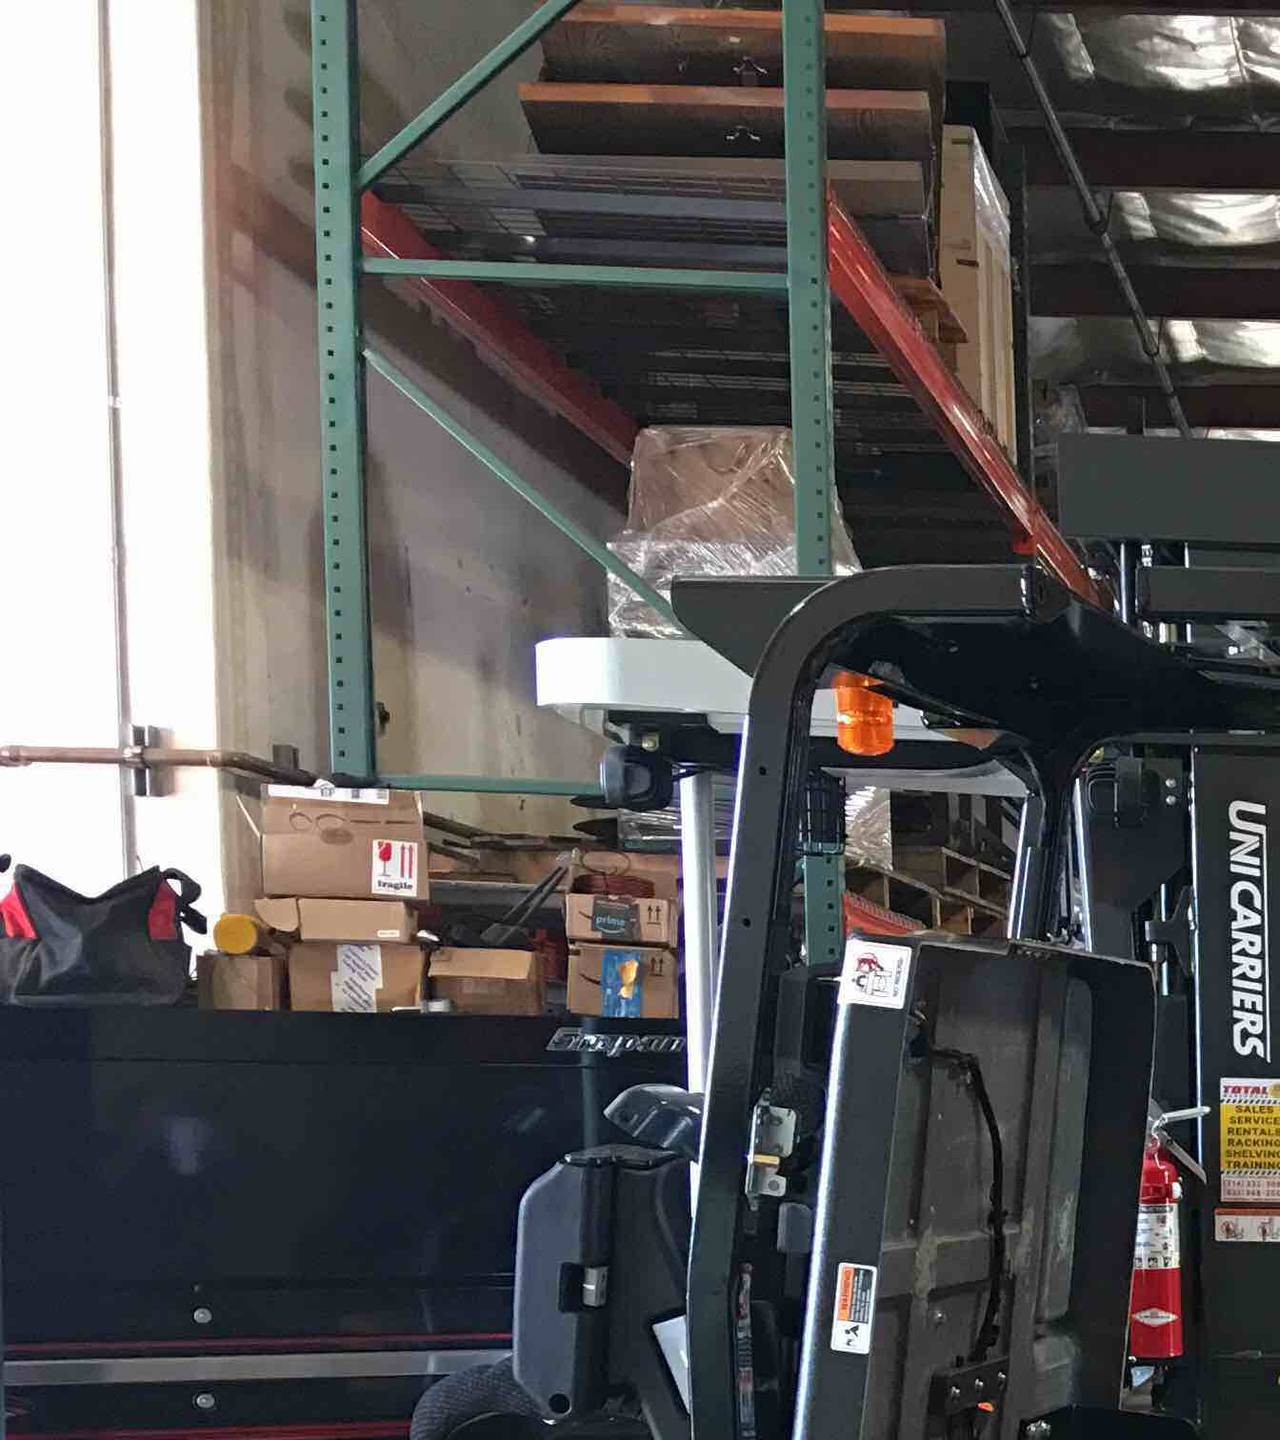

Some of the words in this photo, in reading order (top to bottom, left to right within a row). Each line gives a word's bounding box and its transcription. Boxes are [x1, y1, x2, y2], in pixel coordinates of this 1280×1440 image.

[377, 879, 413, 891] fragile
[1228, 800, 1271, 1063] UNICARRIERS
[1235, 1105, 1274, 1114] SALES
[1229, 1116, 1280, 1125] SERVICE
